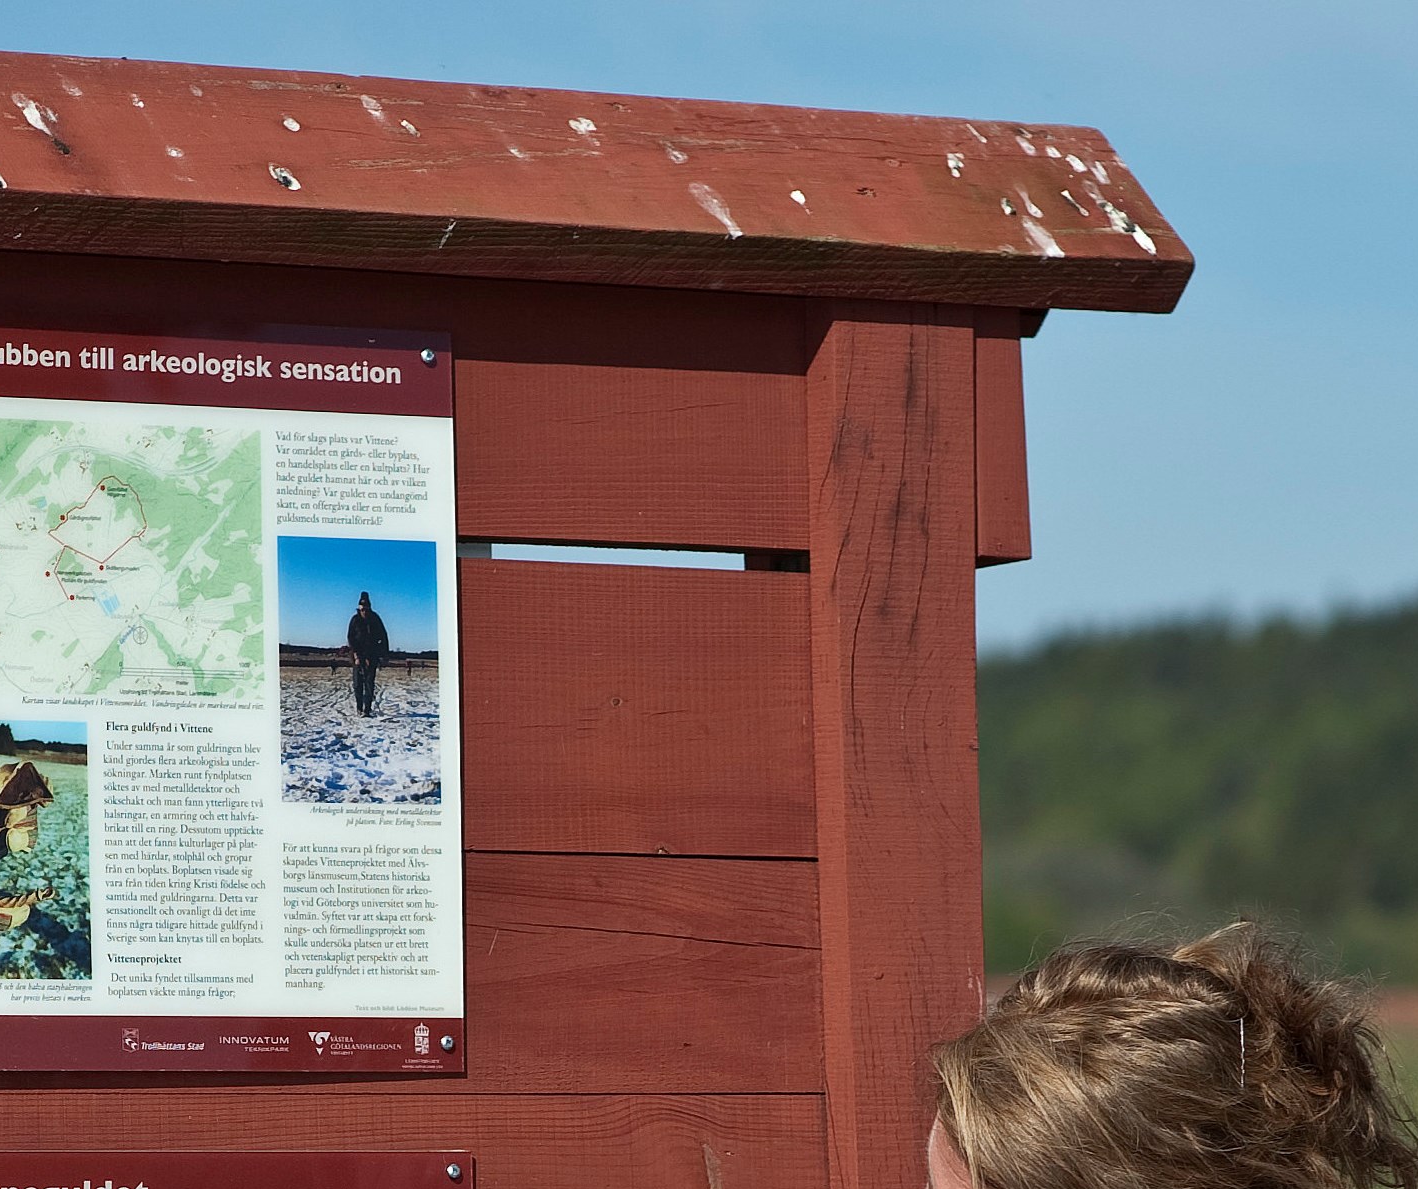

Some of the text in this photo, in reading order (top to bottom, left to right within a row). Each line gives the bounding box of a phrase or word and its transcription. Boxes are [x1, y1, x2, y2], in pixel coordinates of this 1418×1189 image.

[78, 346, 114, 369] till
[122, 349, 272, 382] arkeologisk
[279, 360, 401, 383] sensation
[106, 721, 212, 734] Flera guldfynd i Vittene
[103, 781, 129, 791] söktes
[142, 782, 160, 792] med
[162, 782, 223, 793] metalldetektor
[224, 783, 240, 793] och
[107, 953, 181, 965] Vitteneprojektet
[219, 1035, 289, 1044] INNOVATUM
